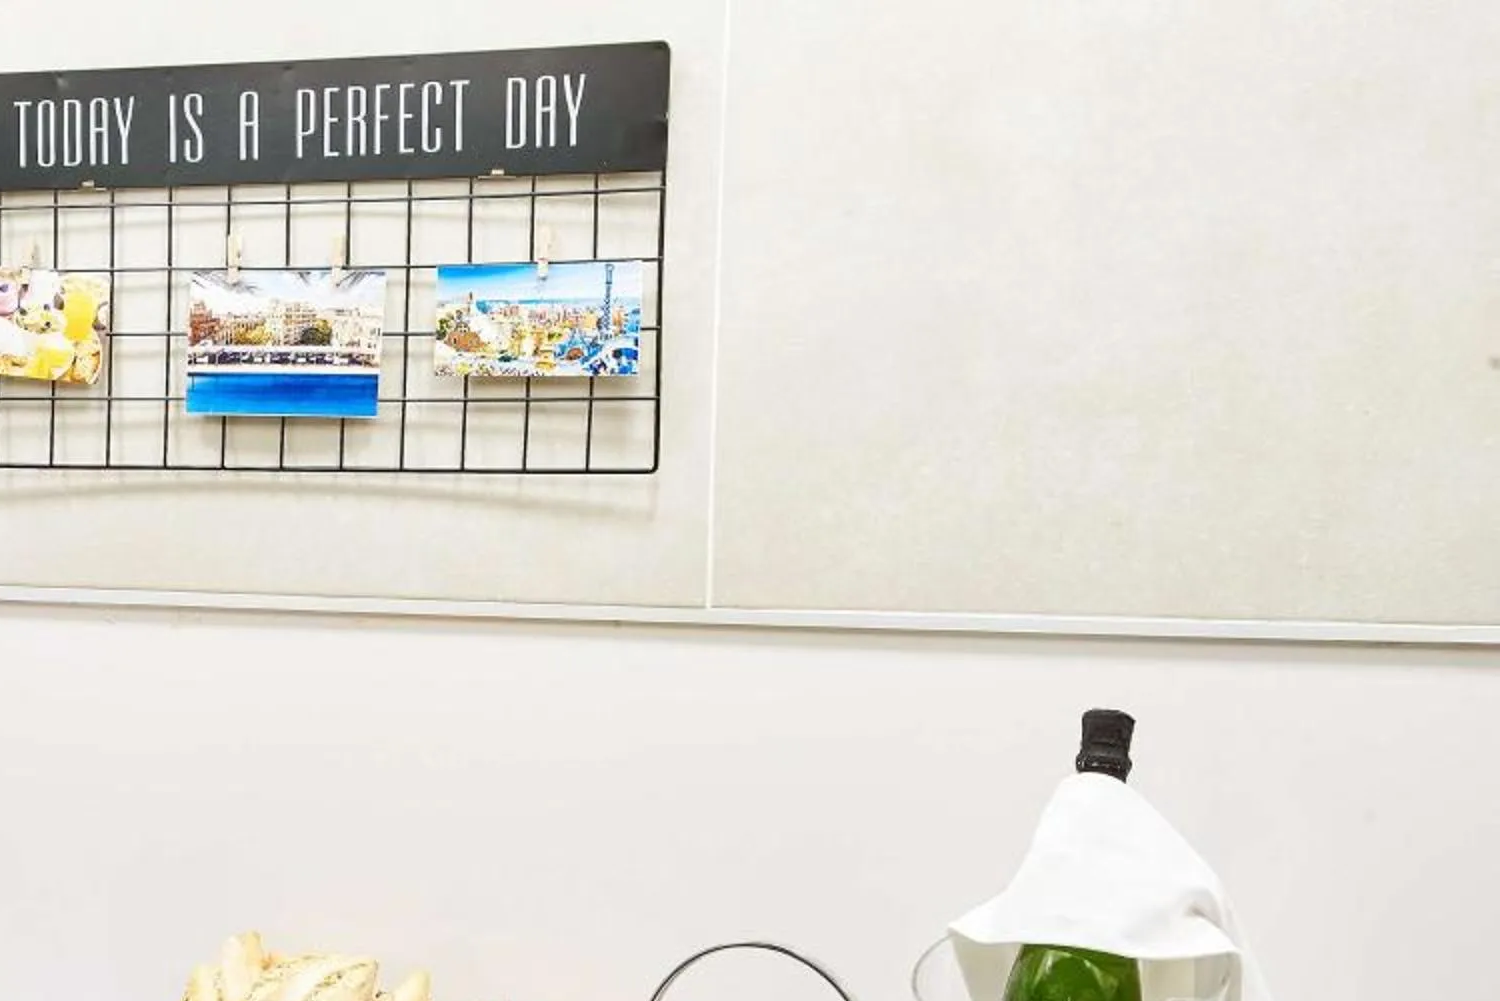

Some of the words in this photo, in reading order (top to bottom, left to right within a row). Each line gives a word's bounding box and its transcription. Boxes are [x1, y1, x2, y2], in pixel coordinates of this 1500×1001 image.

[13, 95, 135, 168] TODAY
[169, 93, 204, 163] IS
[239, 90, 259, 161] A
[296, 79, 471, 159] PERFECT
[505, 73, 587, 149] DAY
